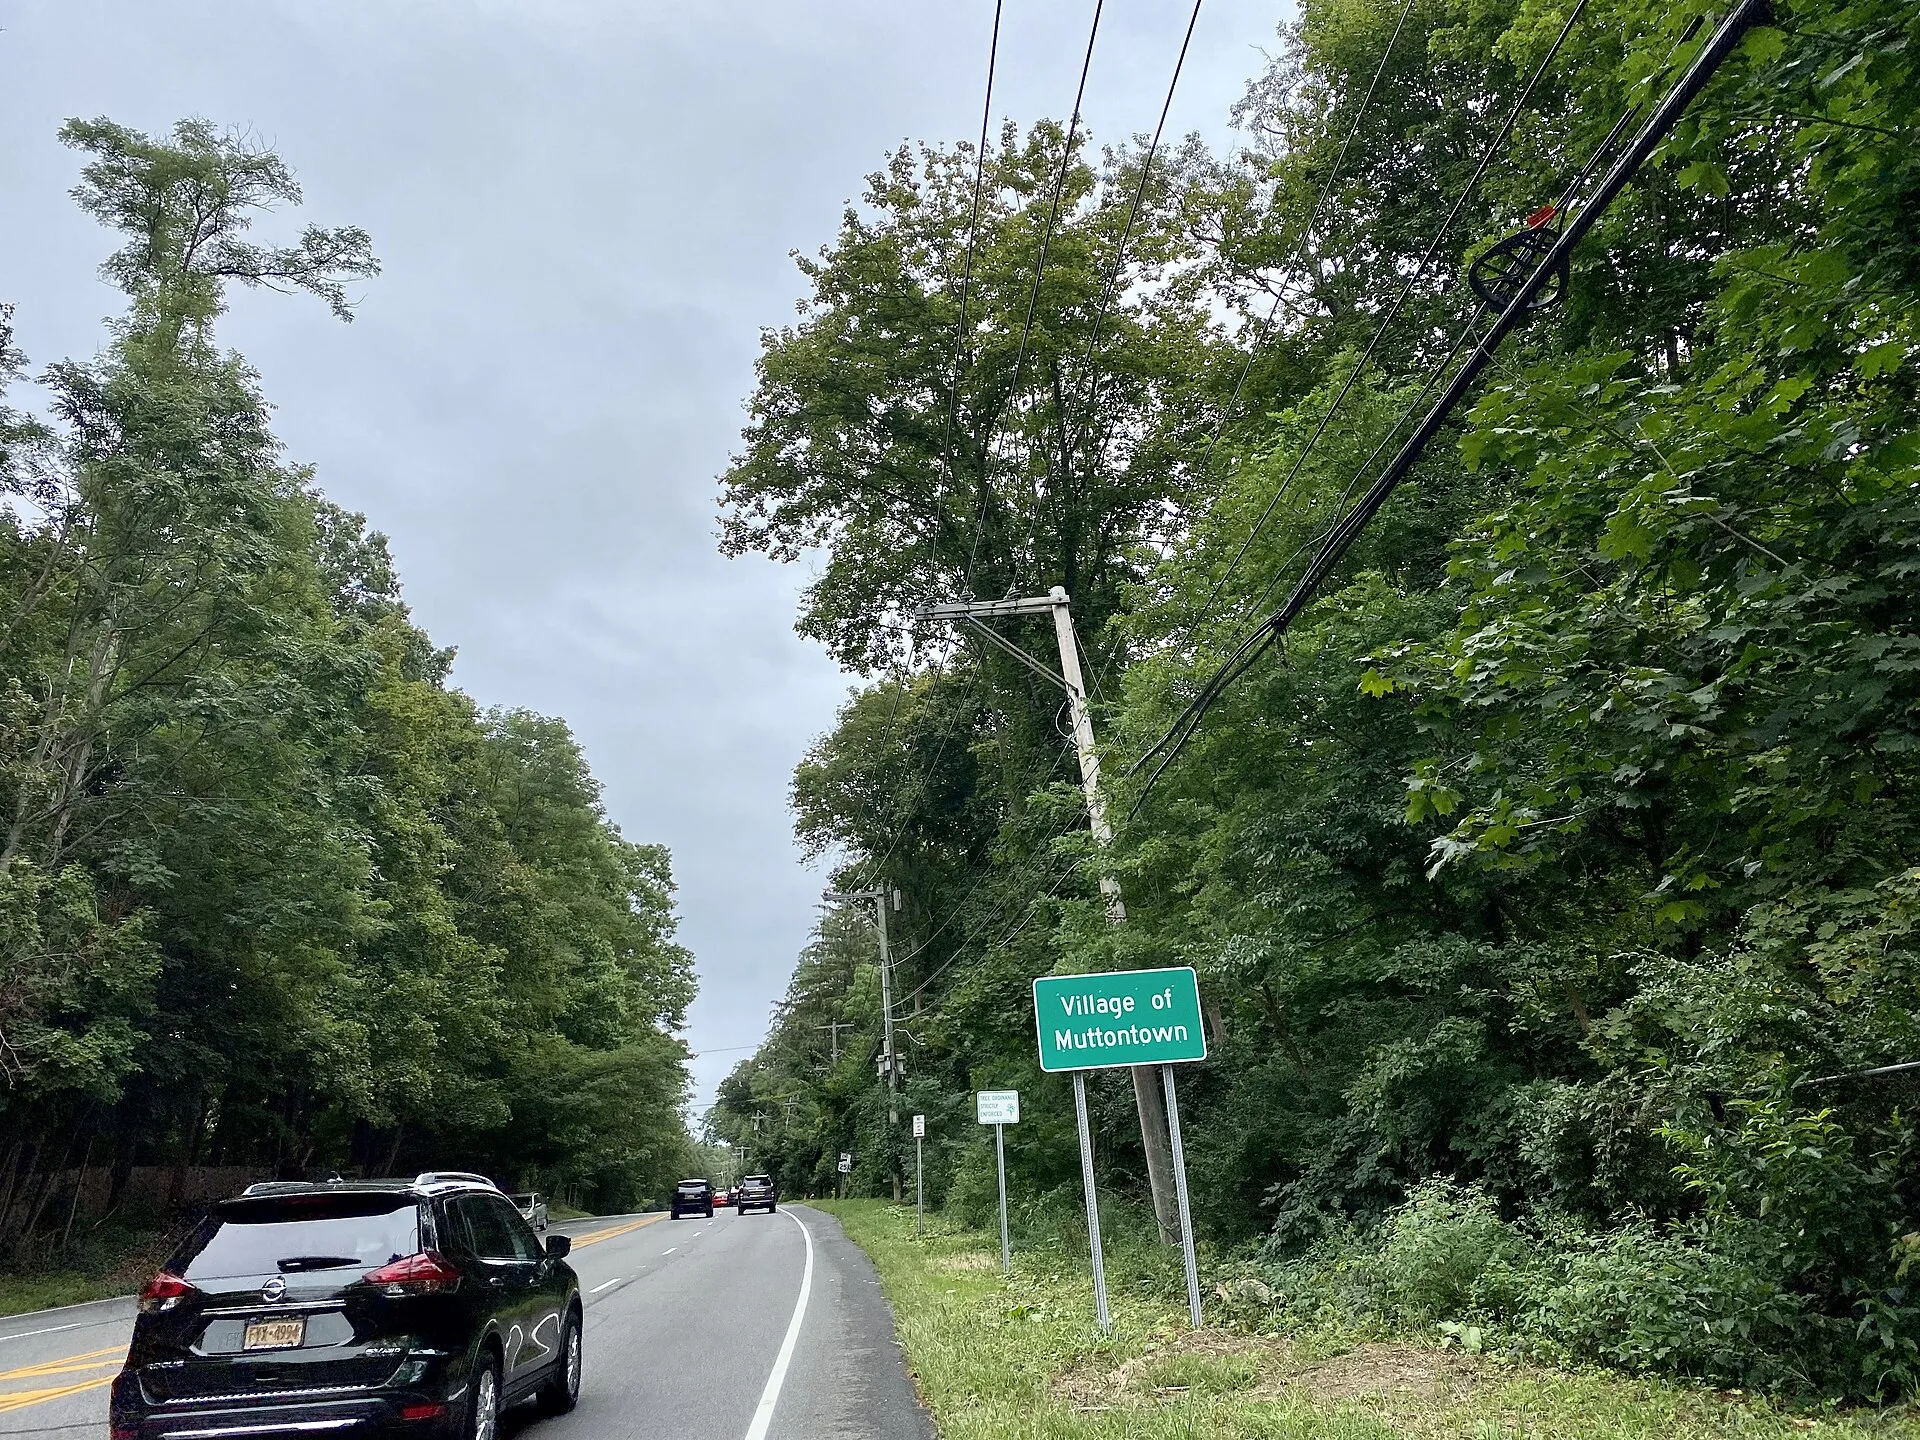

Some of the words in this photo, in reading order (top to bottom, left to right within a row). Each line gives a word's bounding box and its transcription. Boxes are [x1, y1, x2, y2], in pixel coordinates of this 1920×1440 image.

[1060, 993, 1135, 1019] Village
[1151, 988, 1172, 1010] of
[1055, 1024, 1188, 1051] Muttontown
